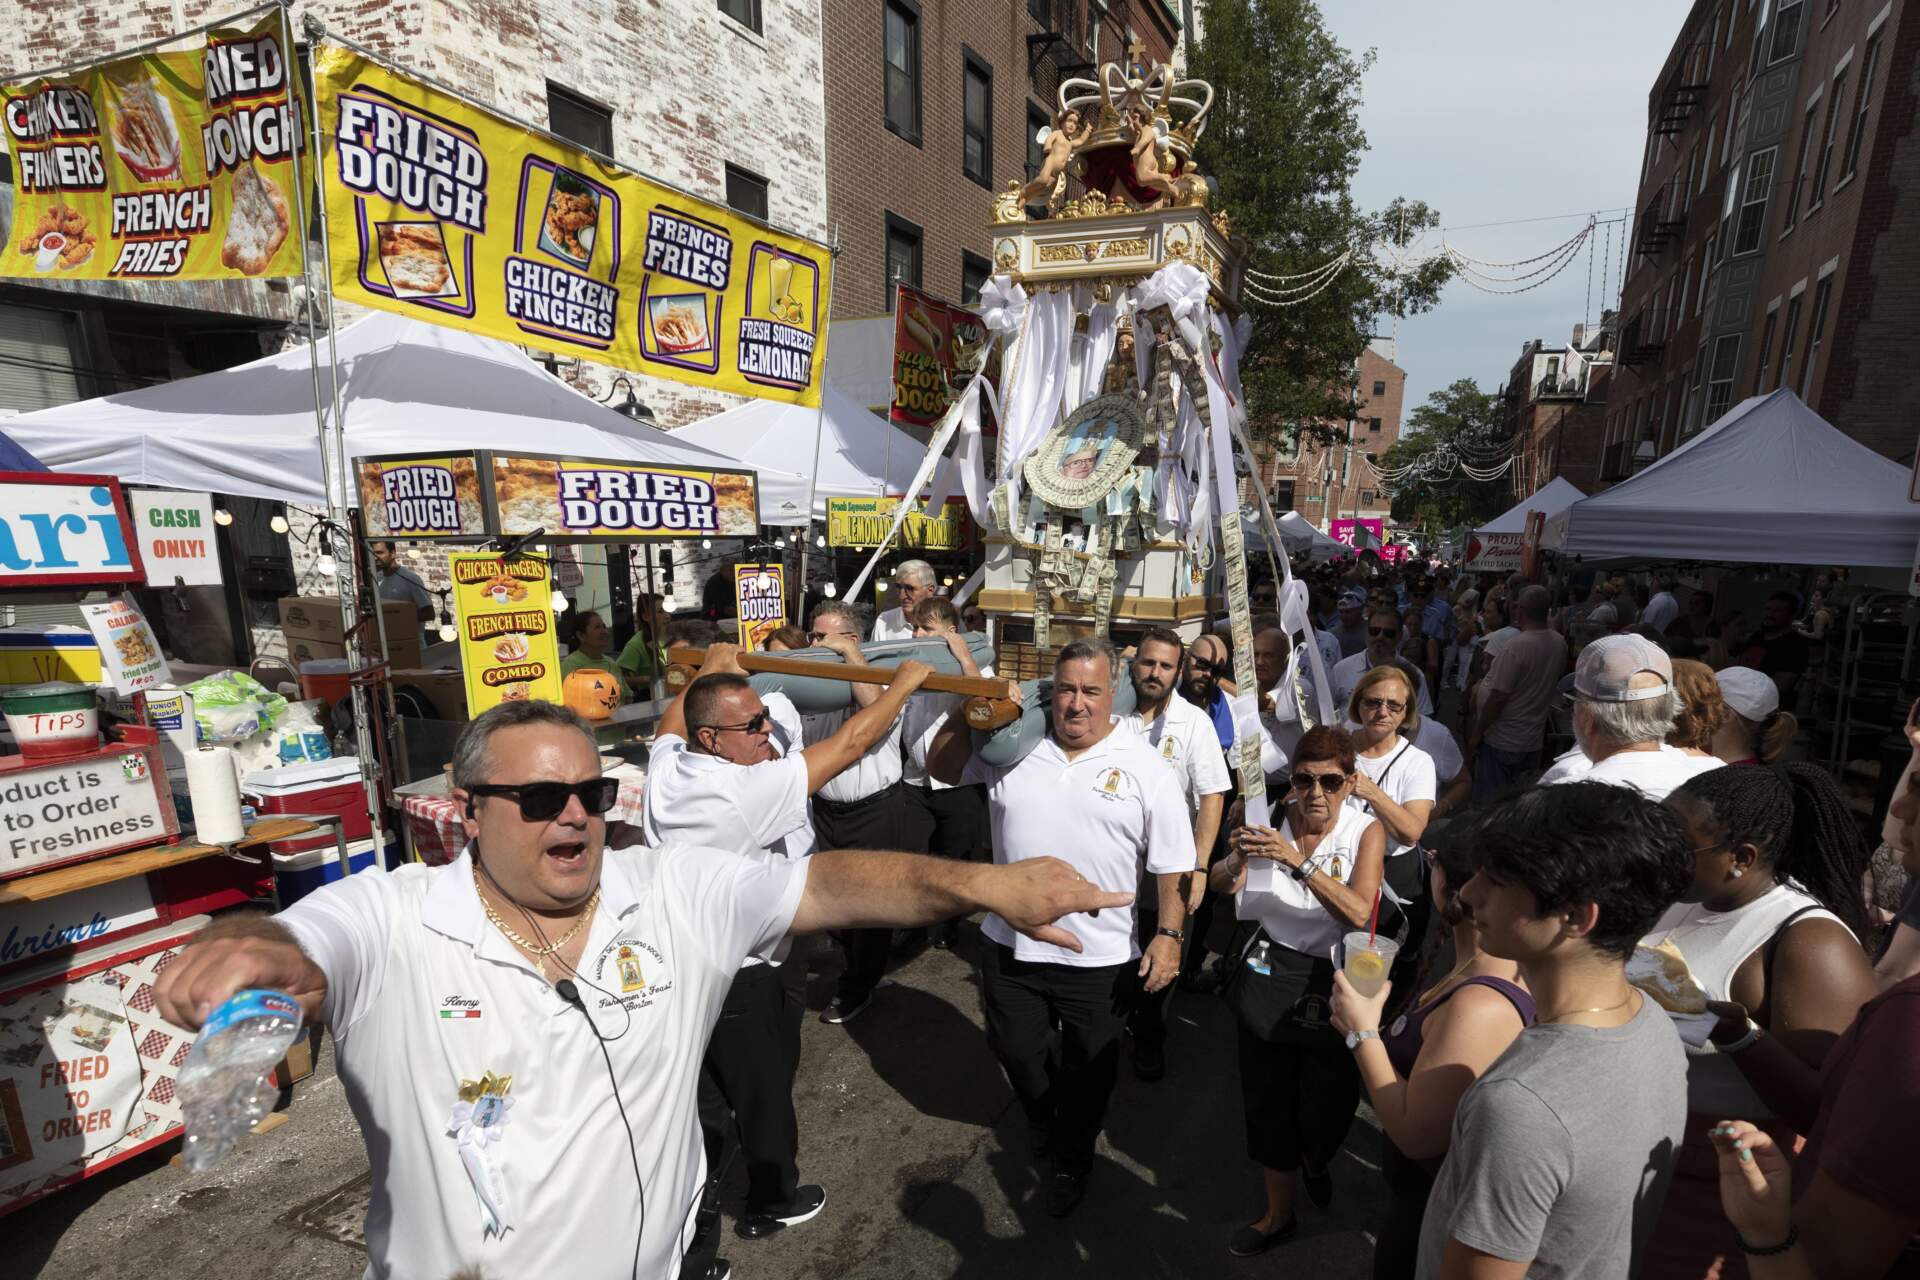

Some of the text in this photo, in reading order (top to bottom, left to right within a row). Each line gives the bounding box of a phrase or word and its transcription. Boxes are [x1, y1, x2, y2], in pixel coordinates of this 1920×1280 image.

[203, 38, 282, 100] RIED
[339, 97, 483, 186] FRIED
[339, 143, 484, 229] DOUGH
[112, 188, 210, 233] FRENCH
[649, 213, 730, 260] FRENCH
[111, 239, 188, 273] FRIES
[645, 239, 728, 289] FRIES
[506, 259, 616, 313] CHICKEN
[508, 290, 612, 338] FINGERS
[741, 320, 816, 352] FRESH SQUEEZE
[739, 342, 809, 383] LEMONAD
[902, 367, 940, 390] HOT
[896, 384, 944, 413] DOGS
[382, 467, 456, 499] FRIED
[561, 471, 715, 503] FRIED
[149, 508, 202, 528] CASH
[387, 498, 460, 530] DOUGH
[563, 499, 717, 530] DOUGH
[848, 515, 897, 545] LEMONAD
[1338, 526, 1356, 534] SAVE
[1488, 535, 1525, 545] PROJEC
[153, 539, 206, 558] ONLY!
[457, 561, 501, 581] CHICKEN
[503, 560, 545, 575] FINGERS
[739, 577, 780, 599] FRD
[741, 598, 782, 620] DOUGH
[470, 612, 545, 638] FRENCH FRIES
[122, 667, 140, 679] Fried
[486, 664, 542, 683] COMBO
[149, 700, 177, 710] JUNIOR
[152, 708, 180, 717] Napkins
[0, 771, 101, 806] duct is
[4, 794, 120, 832] to Order
[10, 814, 155, 859] Freshness
[441, 995, 480, 1010] Kenny
[649, 980, 673, 996] Feast
[626, 999, 654, 1011] Boston
[40, 1054, 110, 1089] FRIED
[65, 1090, 90, 1111] TO
[42, 1108, 112, 1143] ORDER
